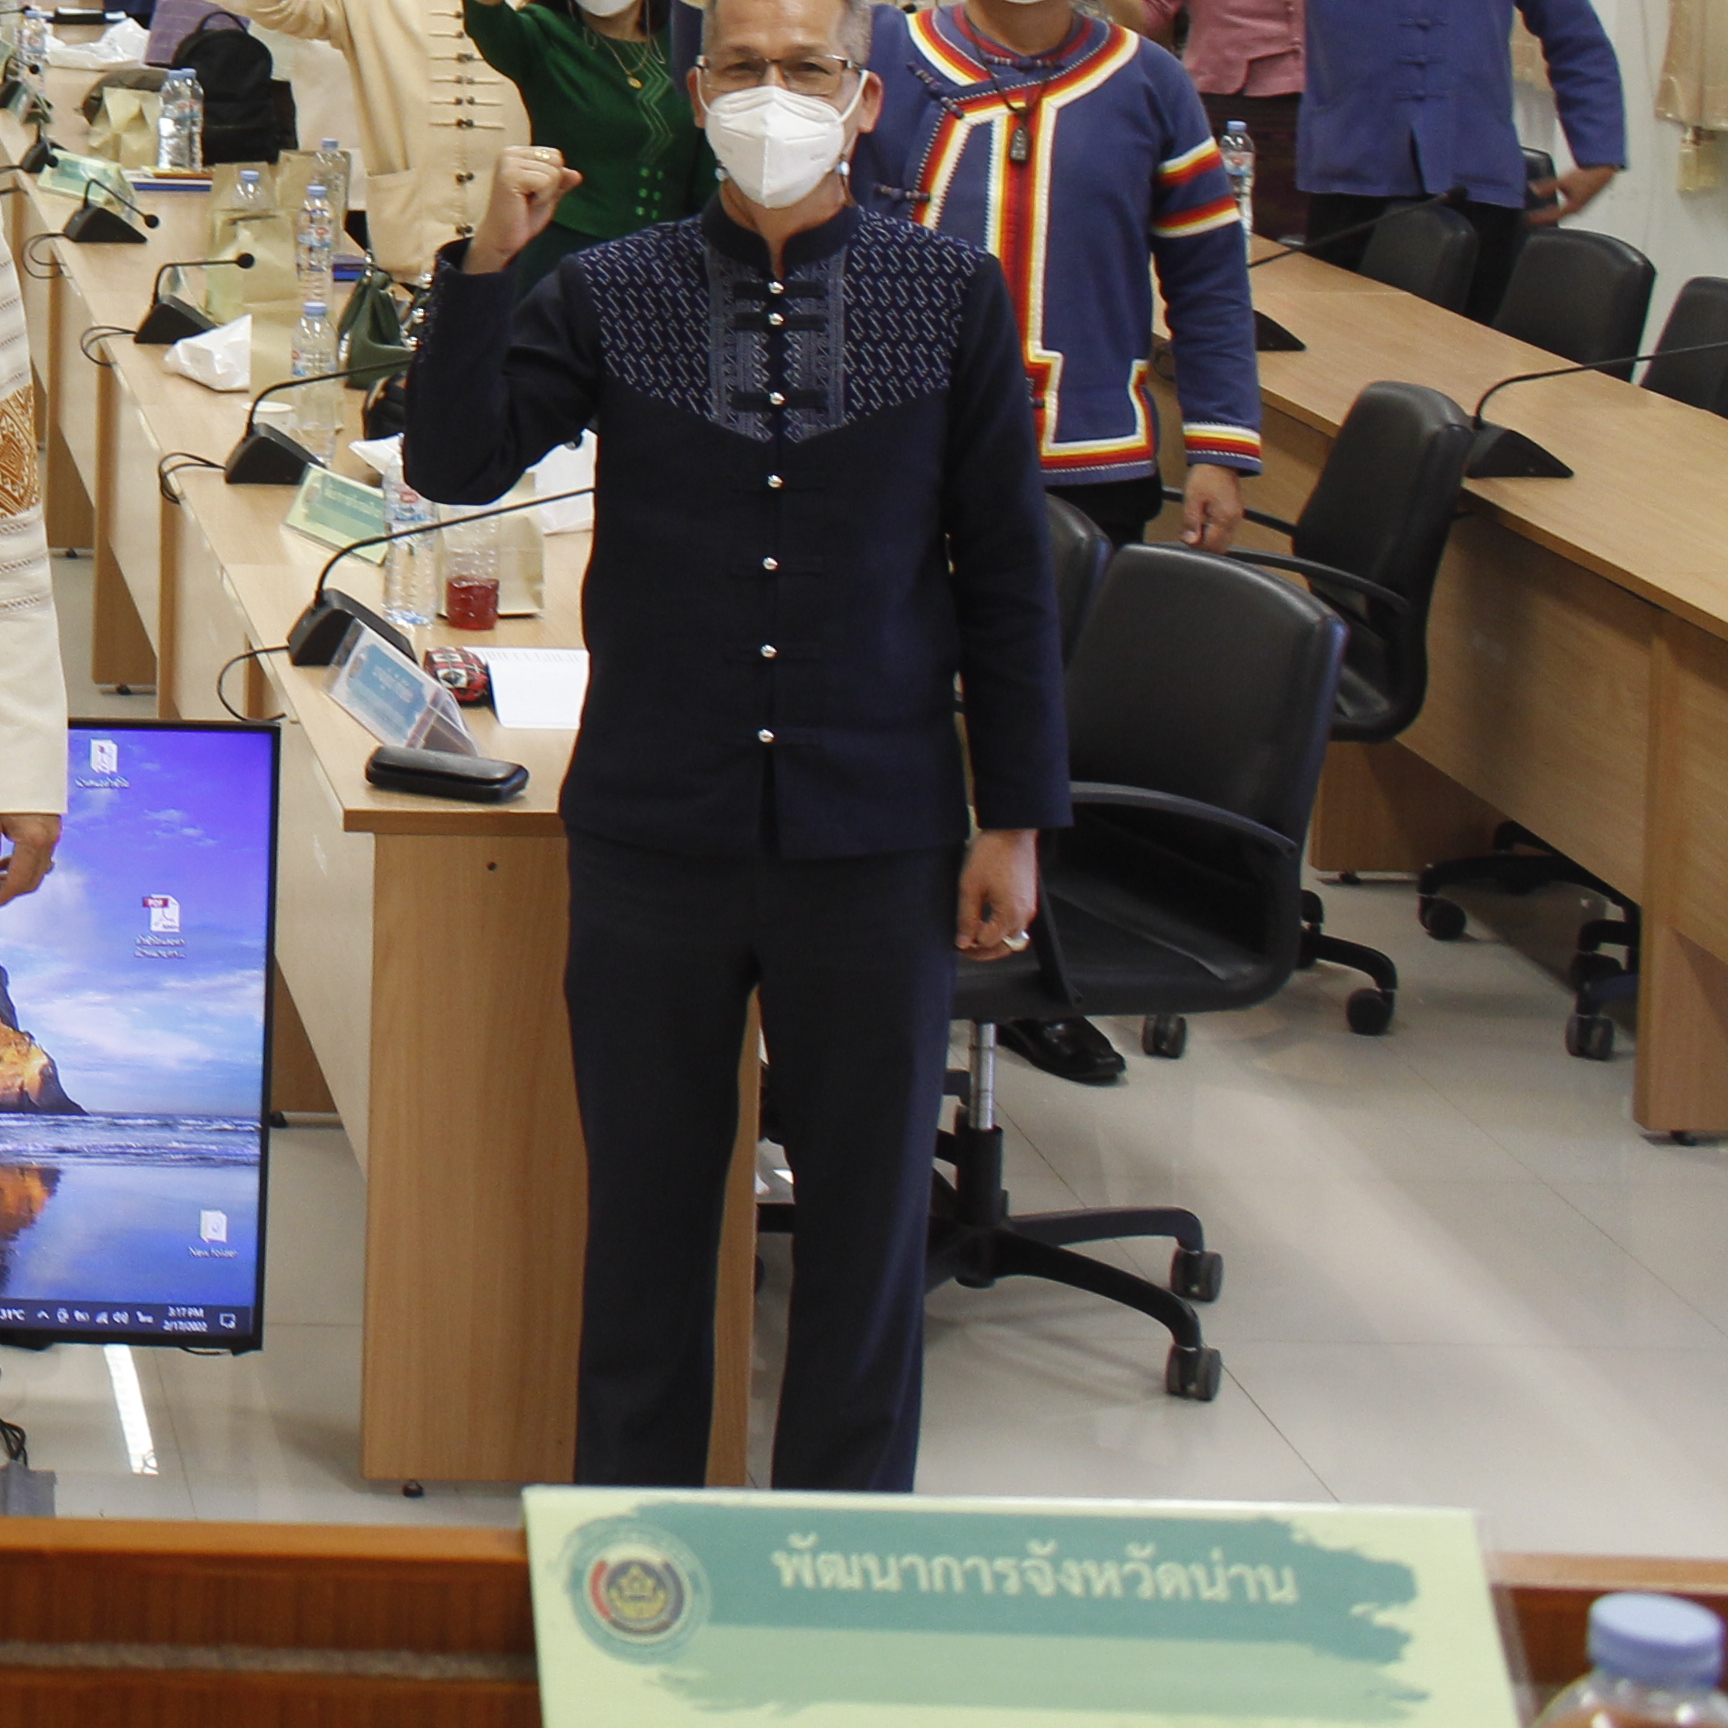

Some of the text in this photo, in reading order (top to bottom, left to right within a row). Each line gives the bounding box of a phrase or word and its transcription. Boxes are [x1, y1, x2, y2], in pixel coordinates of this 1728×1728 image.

[770, 1530, 1299, 1605] พัฒนาการจังหวัดน่าน
